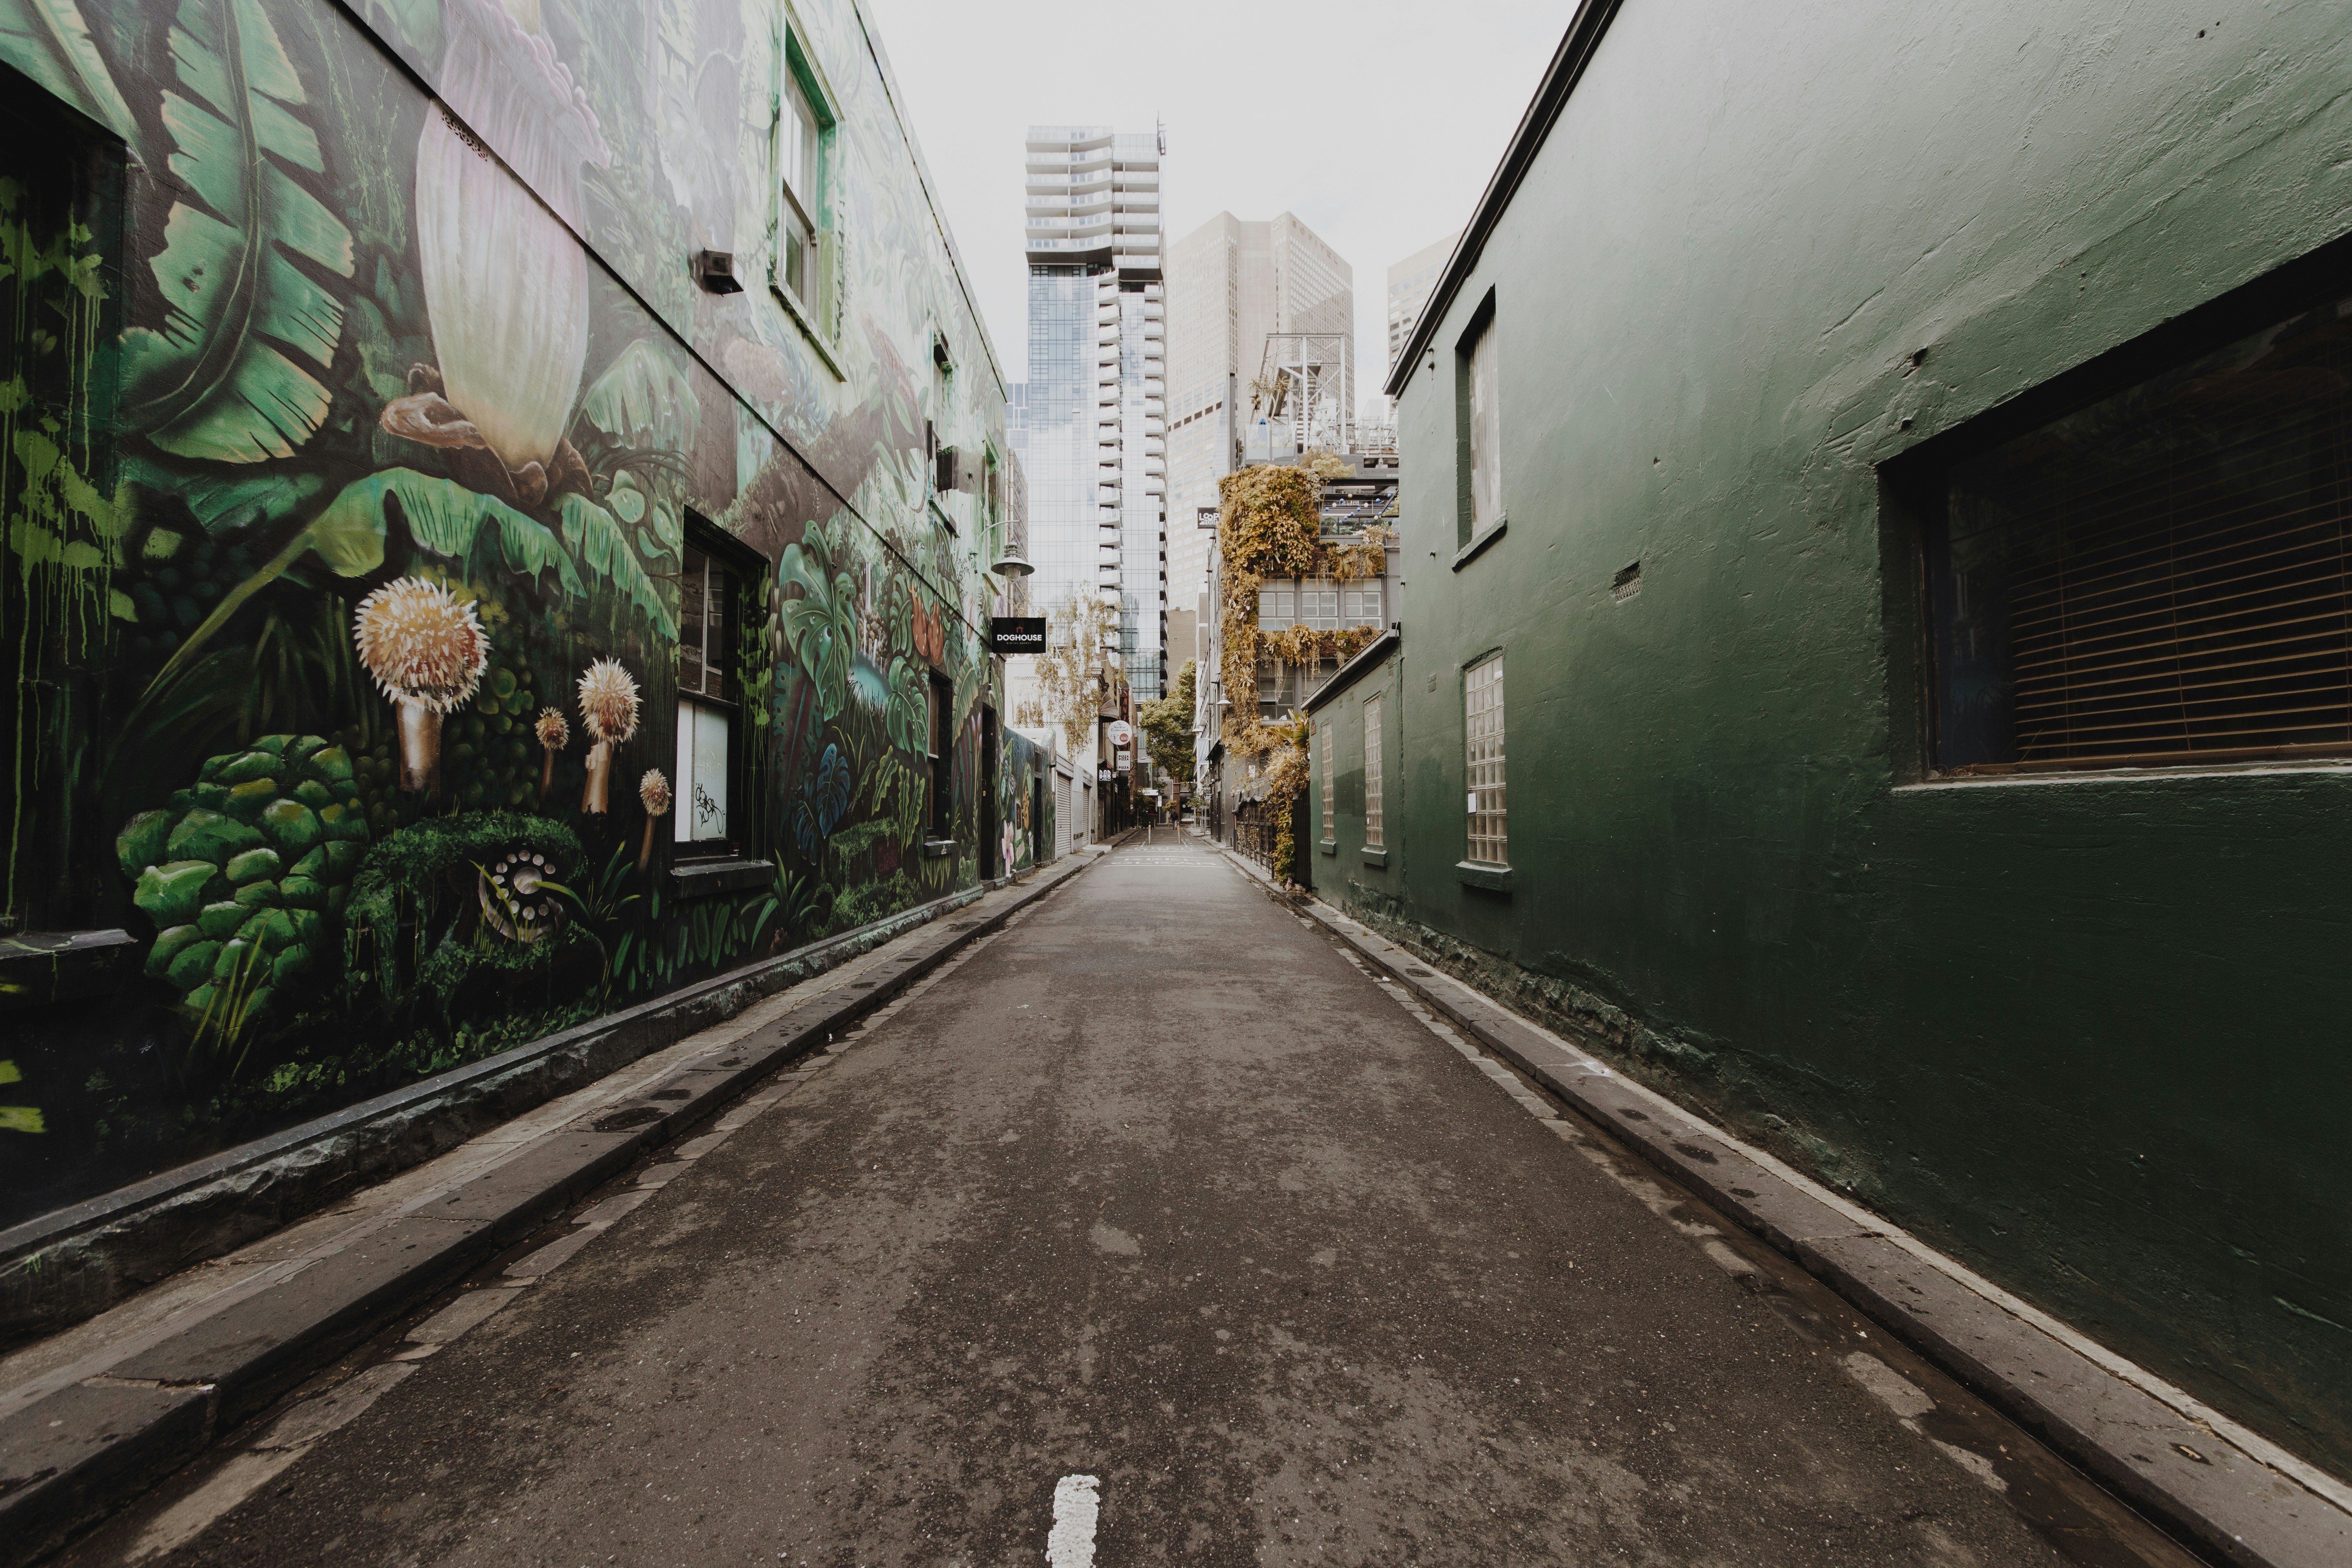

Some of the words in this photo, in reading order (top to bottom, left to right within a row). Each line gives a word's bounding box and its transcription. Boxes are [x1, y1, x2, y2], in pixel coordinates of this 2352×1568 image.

[1292, 220, 1339, 265] SOFITEL
[1199, 512, 1219, 521] LOOP
[1099, 769, 1111, 779] BAR
